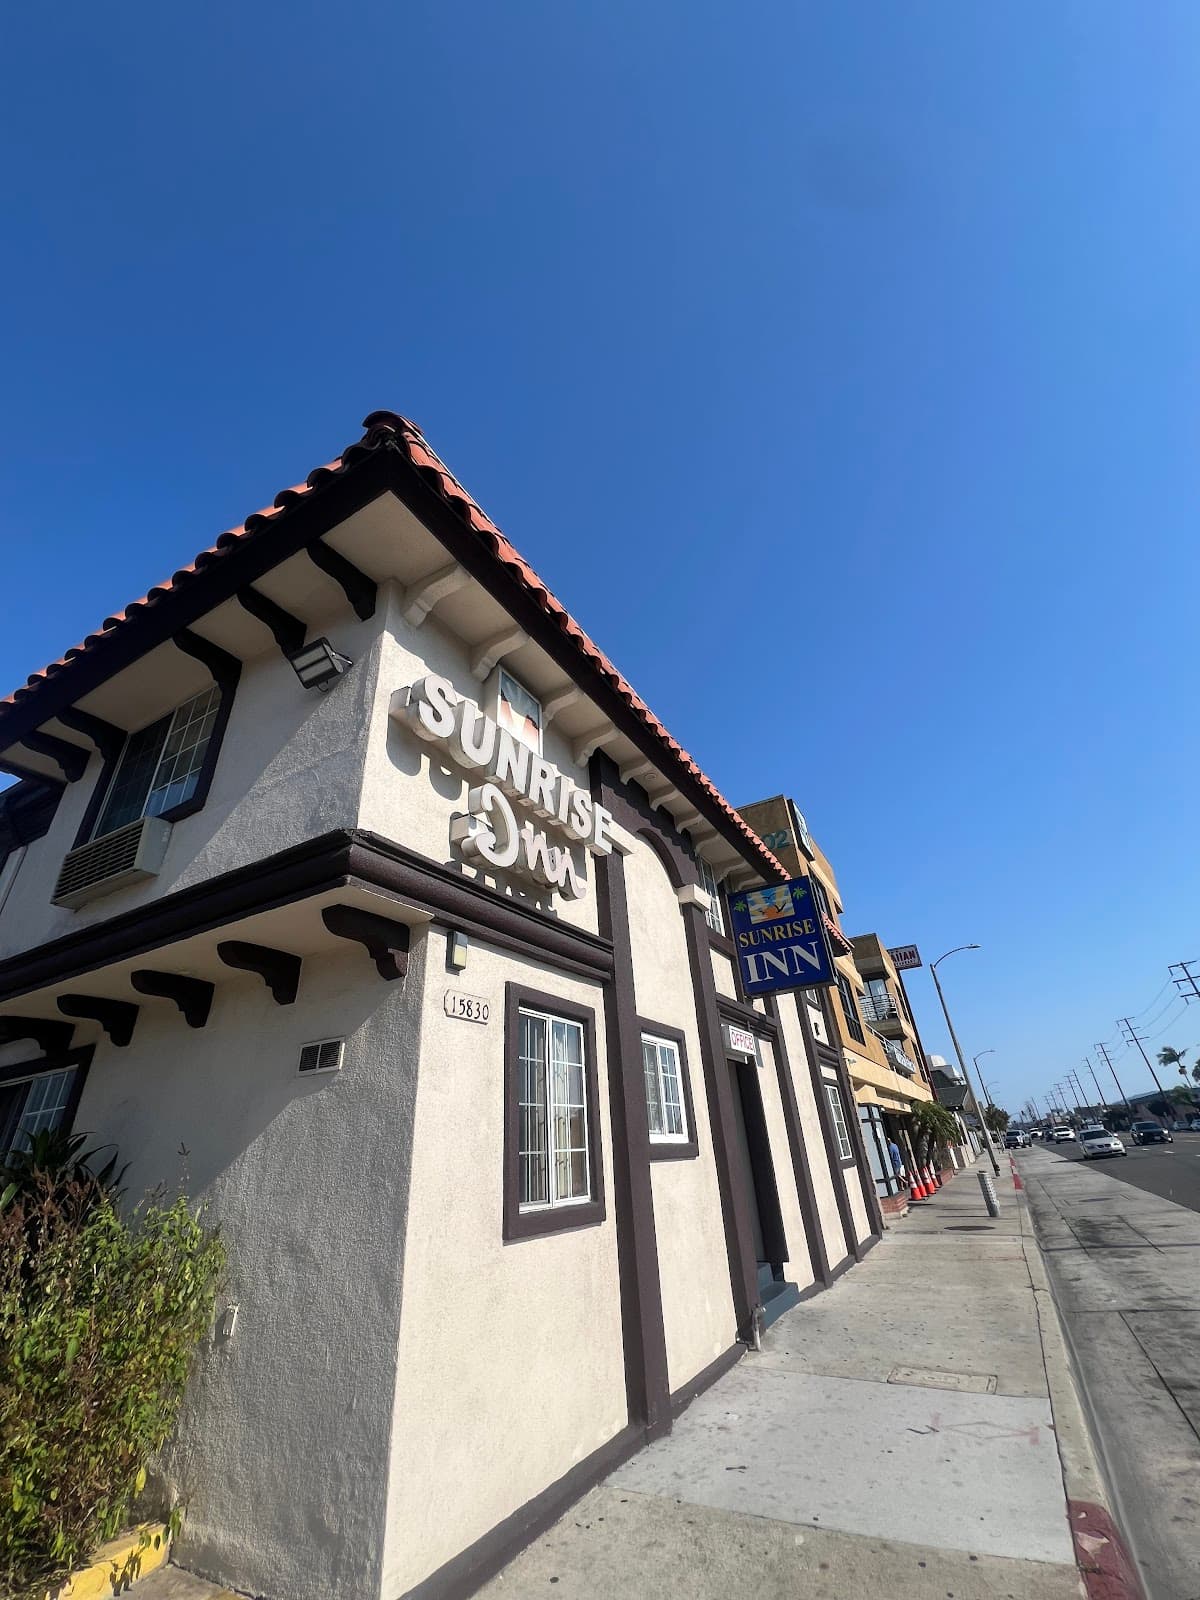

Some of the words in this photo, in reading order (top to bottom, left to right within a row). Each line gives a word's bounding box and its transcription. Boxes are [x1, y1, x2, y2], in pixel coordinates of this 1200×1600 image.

[417, 675, 613, 856] SUNRISE
[739, 918, 816, 948] SUNRISE
[743, 940, 821, 984] INN
[452, 996, 489, 1021] 15830
[731, 1031, 754, 1051] OFFICE
